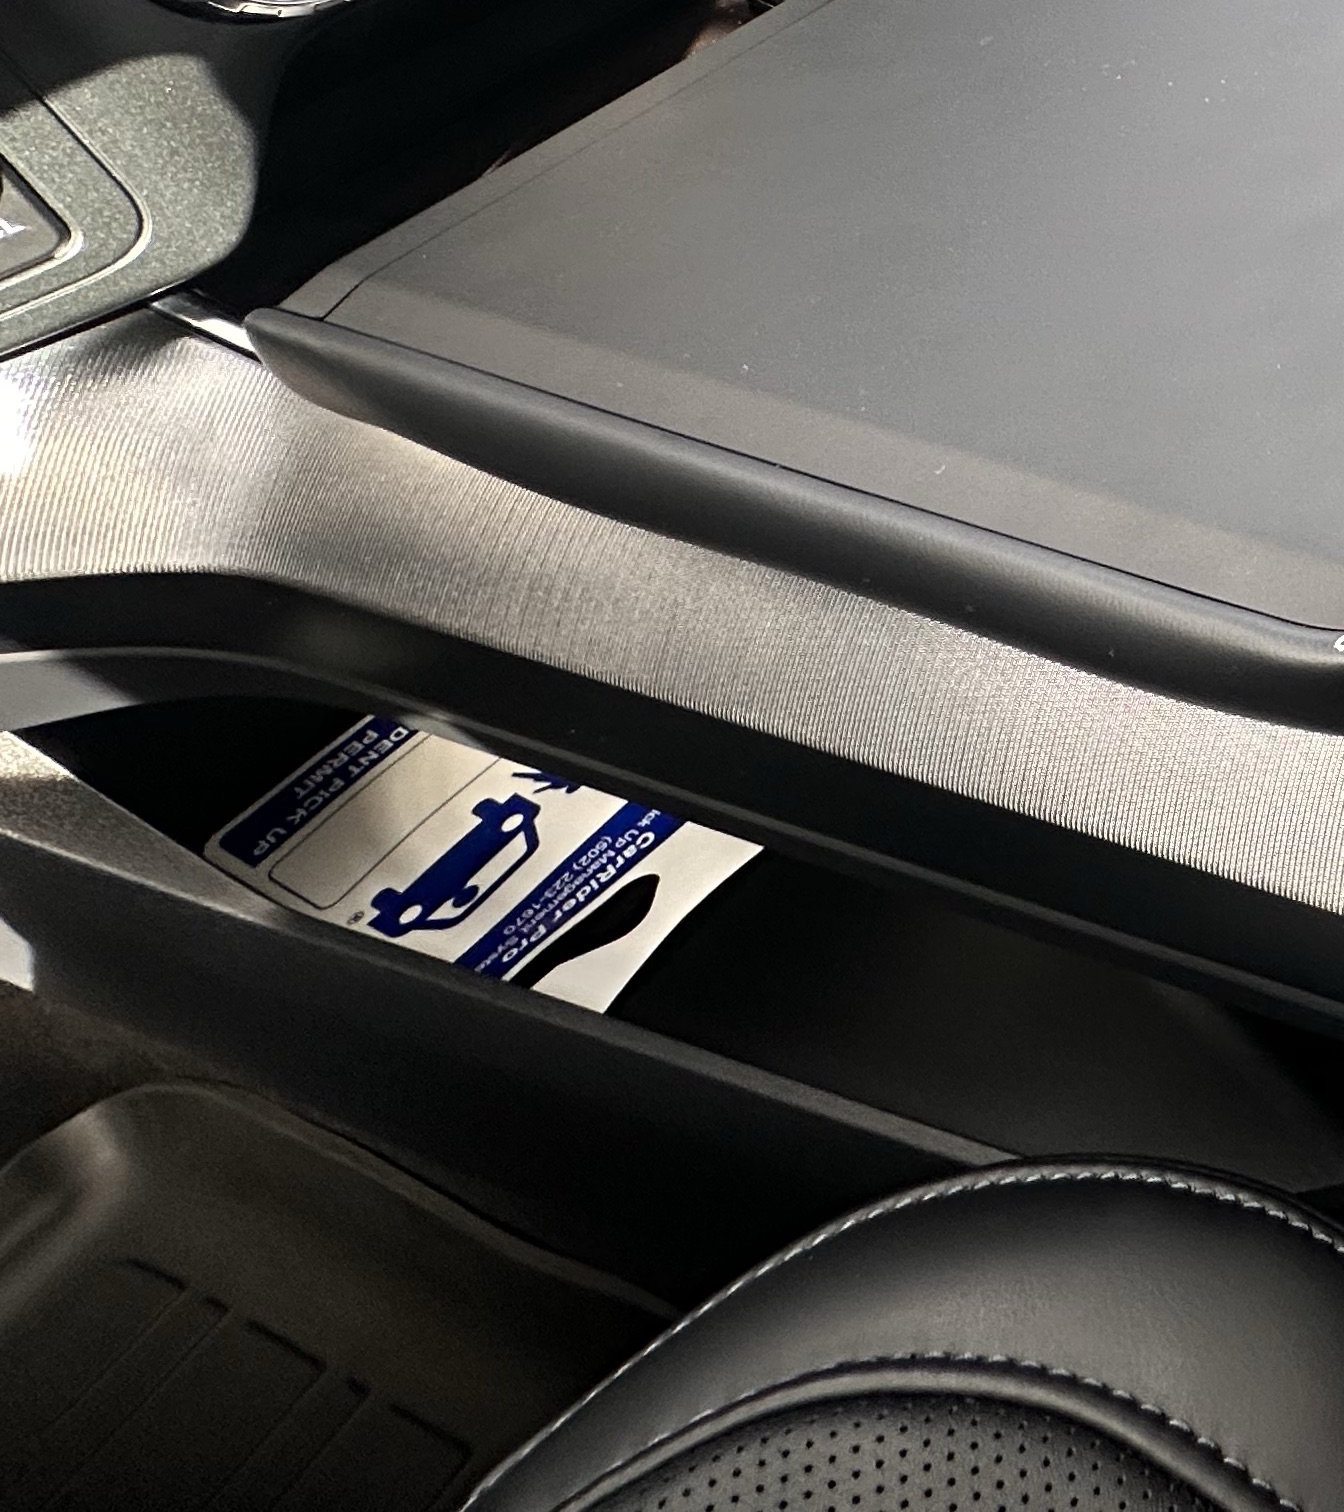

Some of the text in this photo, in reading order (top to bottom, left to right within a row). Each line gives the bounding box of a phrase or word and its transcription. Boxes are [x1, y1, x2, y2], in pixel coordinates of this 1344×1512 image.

[253, 725, 410, 857] DENT PICK UP
[294, 729, 380, 800] PERMIT
[615, 829, 640, 849] Up
[637, 809, 661, 828] ick
[501, 831, 656, 963] CarRider Pro
[518, 849, 616, 935] Management
